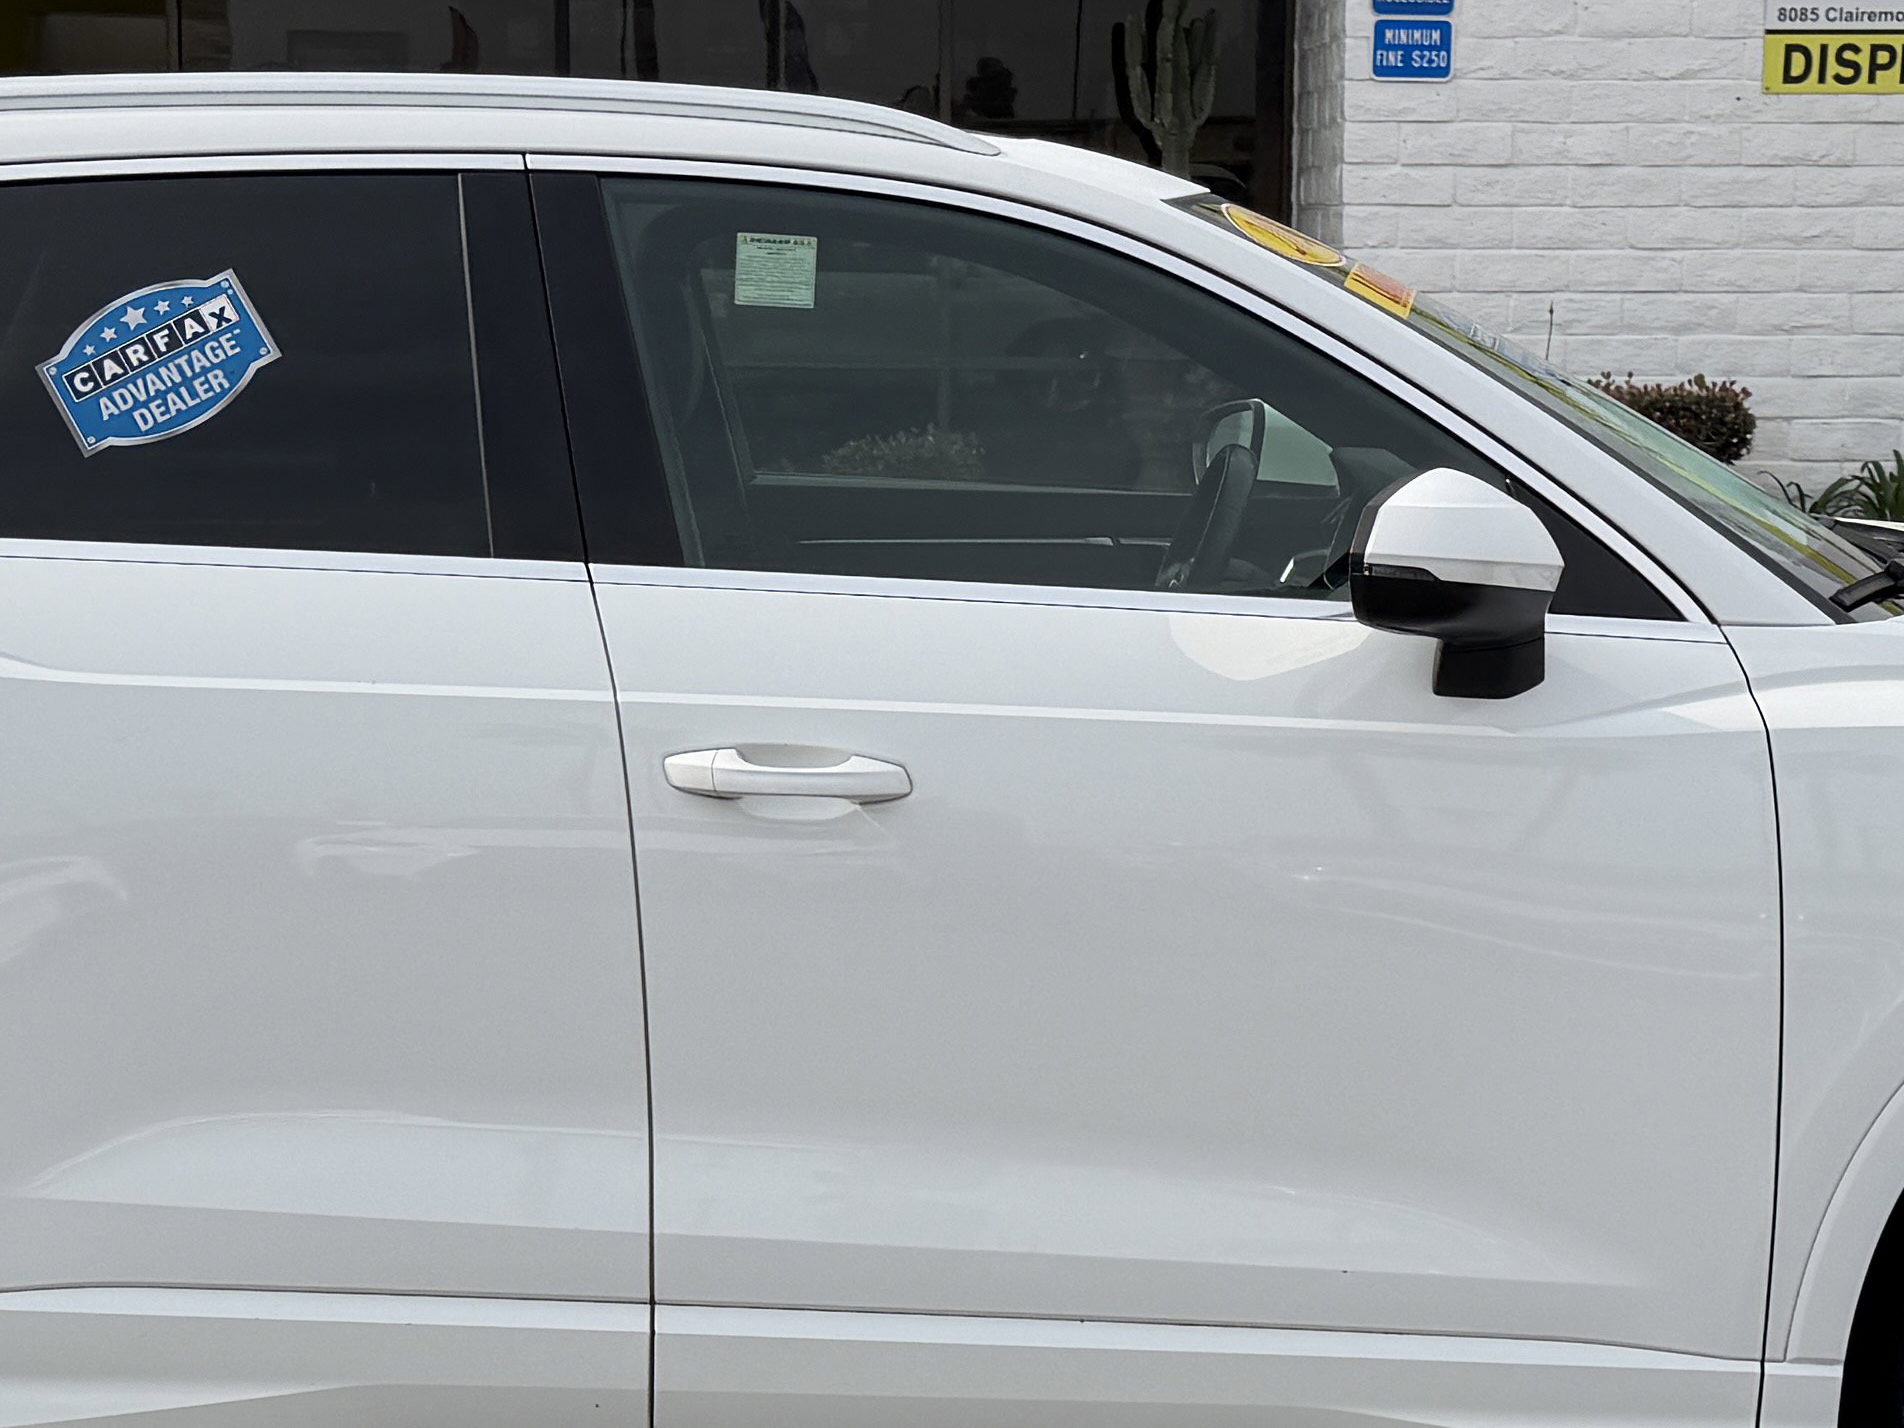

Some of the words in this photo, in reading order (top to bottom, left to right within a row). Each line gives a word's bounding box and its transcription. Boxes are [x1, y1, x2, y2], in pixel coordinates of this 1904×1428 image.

[1777, 7, 1820, 23] 8085
[1384, 28, 1441, 46] MINIMUM
[1375, 50, 1405, 67] FINE
[1411, 50, 1448, 68] $250
[72, 305, 234, 393] CARFAX
[98, 335, 242, 421] ADVANTAGE
[132, 369, 231, 432] DEALER
